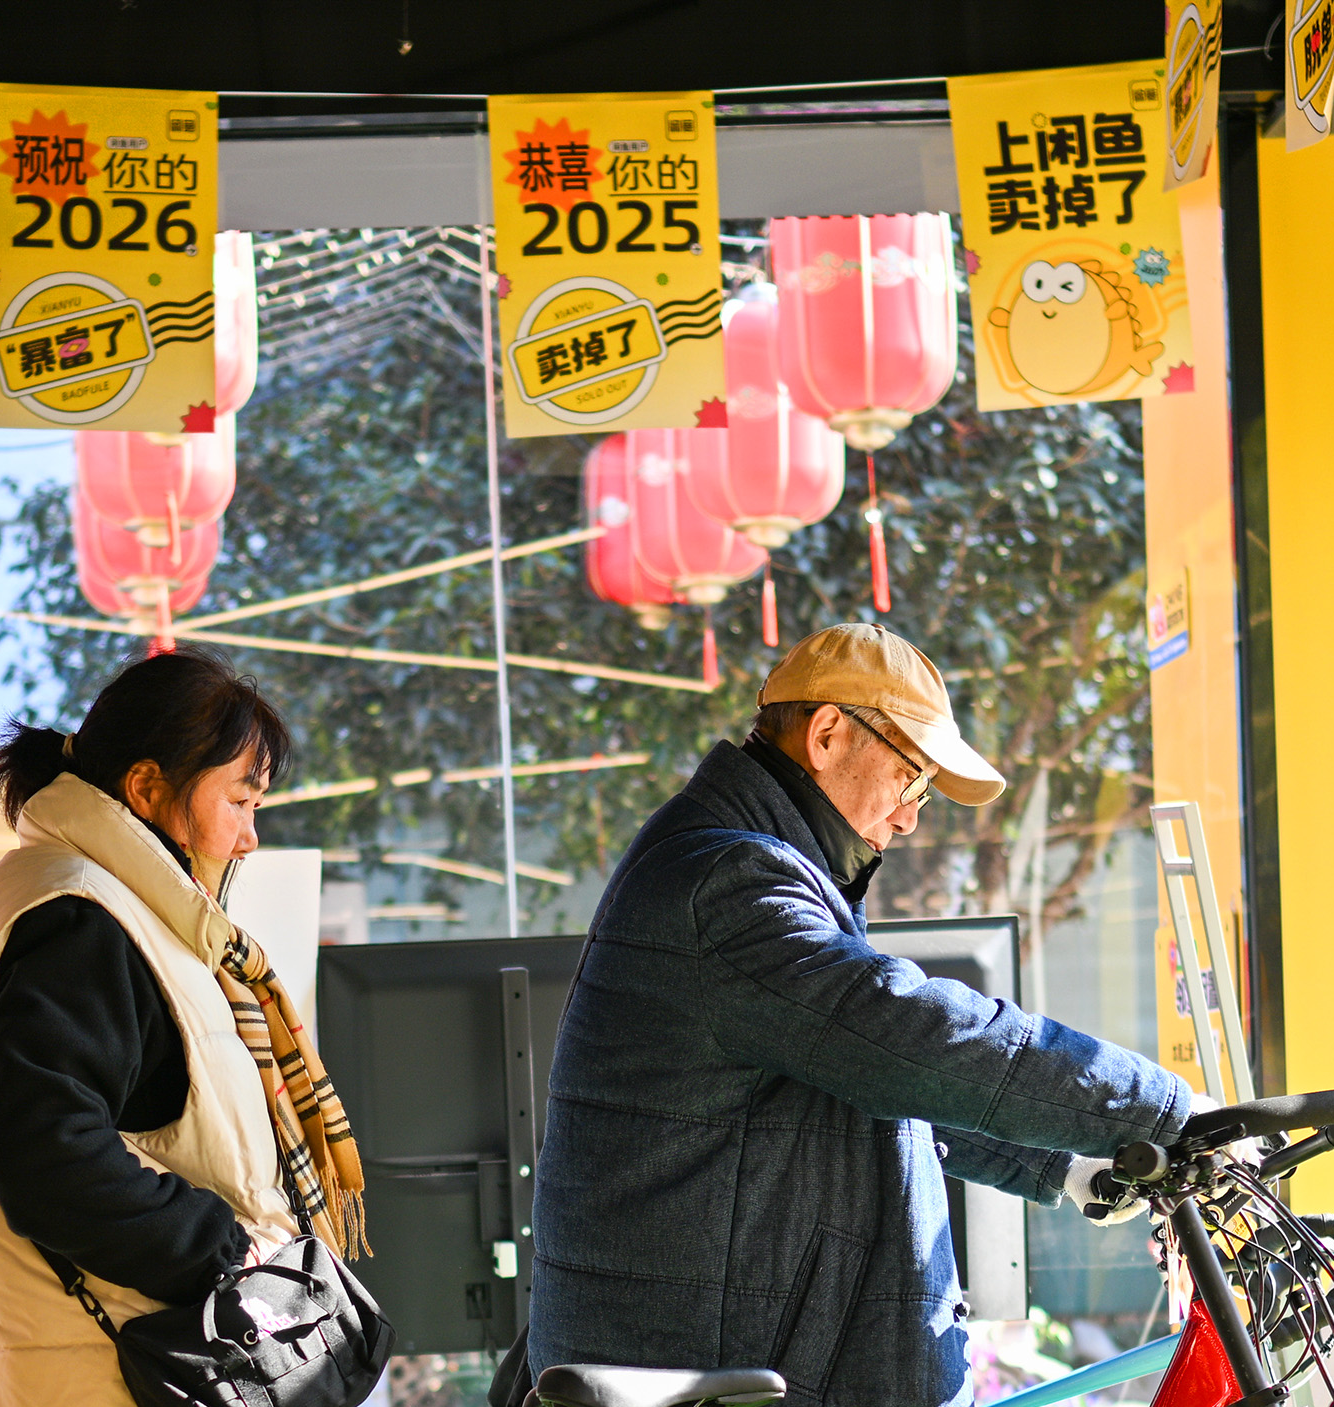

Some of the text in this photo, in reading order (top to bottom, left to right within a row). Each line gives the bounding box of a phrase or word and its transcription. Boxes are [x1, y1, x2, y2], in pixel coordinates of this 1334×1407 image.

[14, 135, 197, 191] 预祝 你的
[519, 141, 698, 192] 恭喜 你的
[984, 113, 1147, 177] 上闲鱼
[12, 195, 197, 252] 2026
[522, 200, 700, 256] 2025
[987, 170, 1147, 235] 卖掉了
[537, 319, 637, 385] 卖掉了
[62, 381, 110, 401] BAOFULE
[576, 379, 627, 405] SOLD OUT
